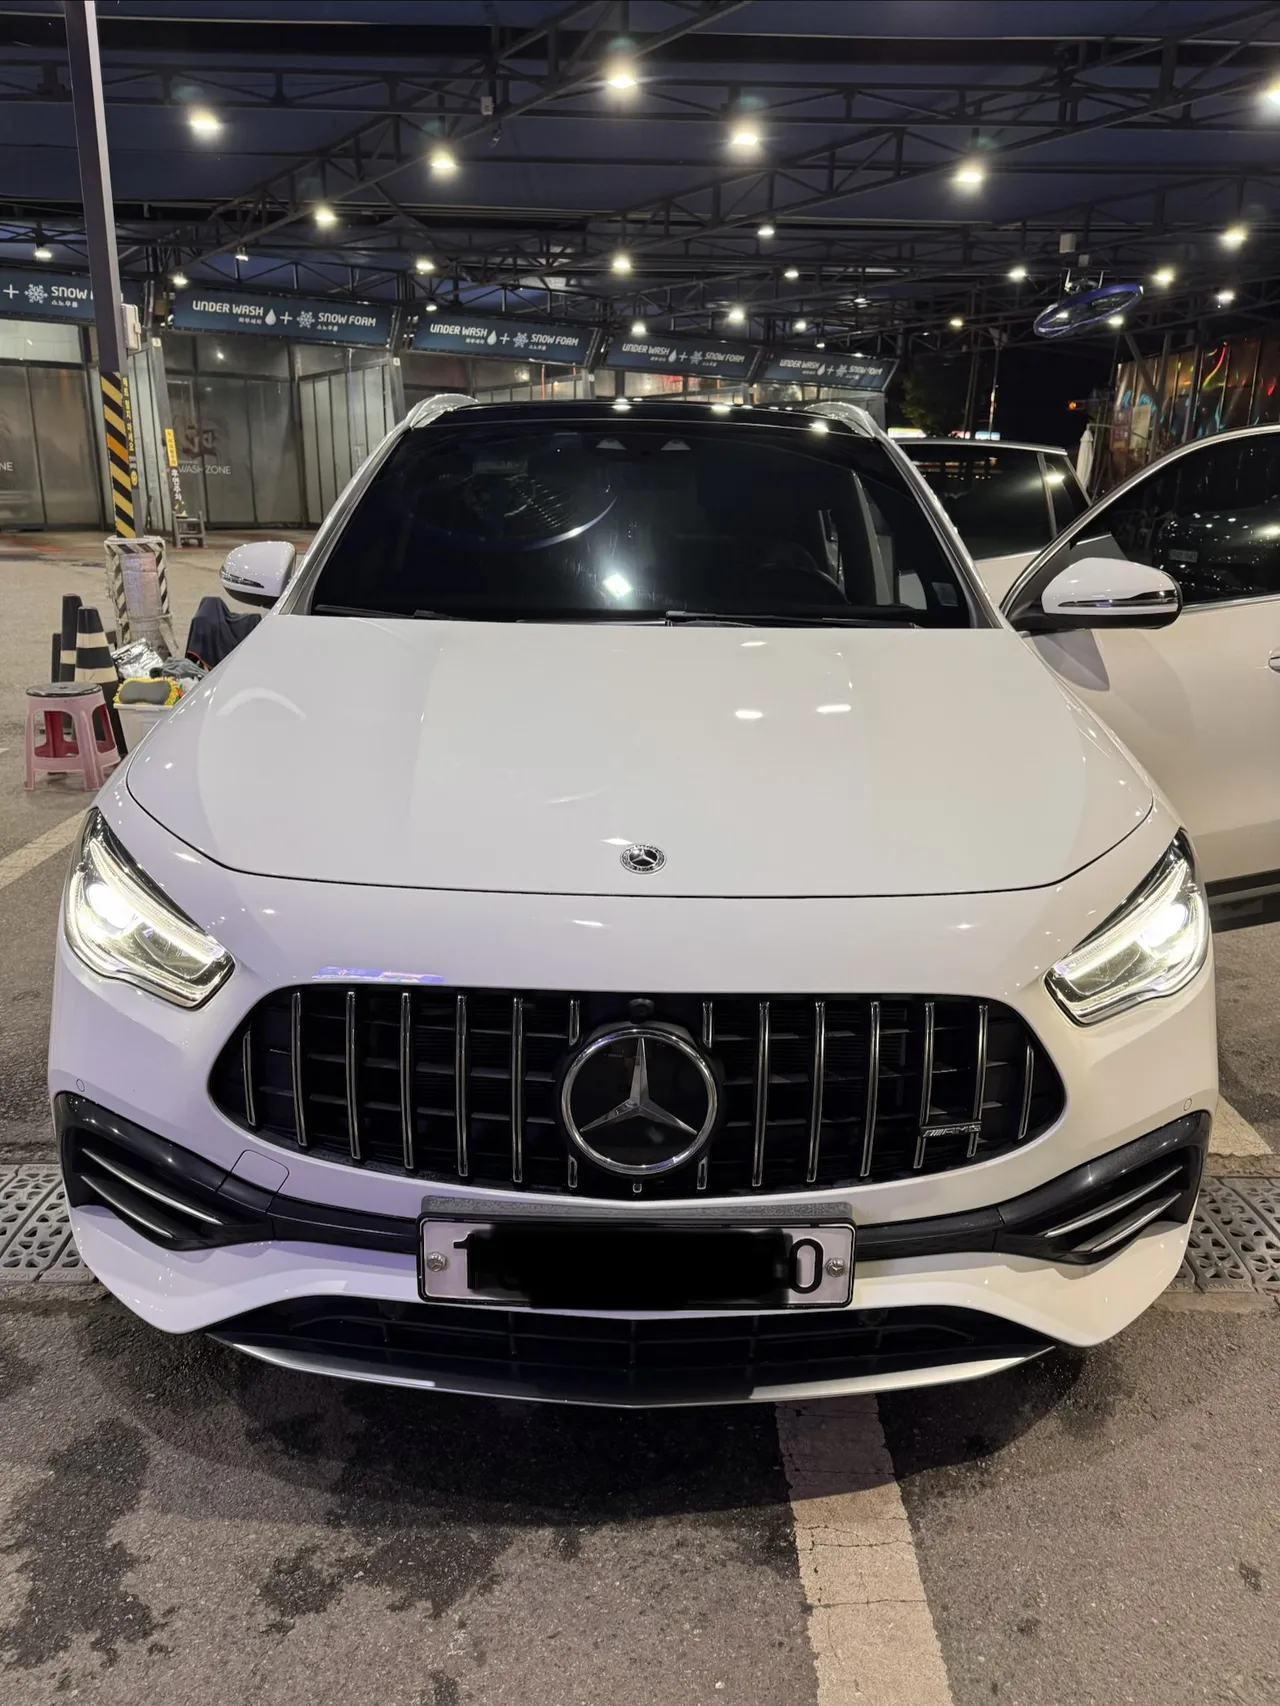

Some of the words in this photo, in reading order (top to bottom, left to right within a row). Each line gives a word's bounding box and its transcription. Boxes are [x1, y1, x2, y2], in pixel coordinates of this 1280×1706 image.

[50, 285, 88, 300] SNOW
[192, 300, 230, 313] UNDER
[232, 303, 264, 317] WASH
[318, 312, 348, 324] SNOW
[349, 316, 377, 327] FOAM
[430, 323, 461, 335] UNDER
[462, 326, 488, 338] WASH
[530, 333, 556, 344] SNOW
[556, 336, 579, 346] FOAM
[622, 343, 648, 354] UNDER
[648, 345, 671, 355] WASH
[179, 464, 204, 474] WASH
[205, 465, 232, 475] ZONE
